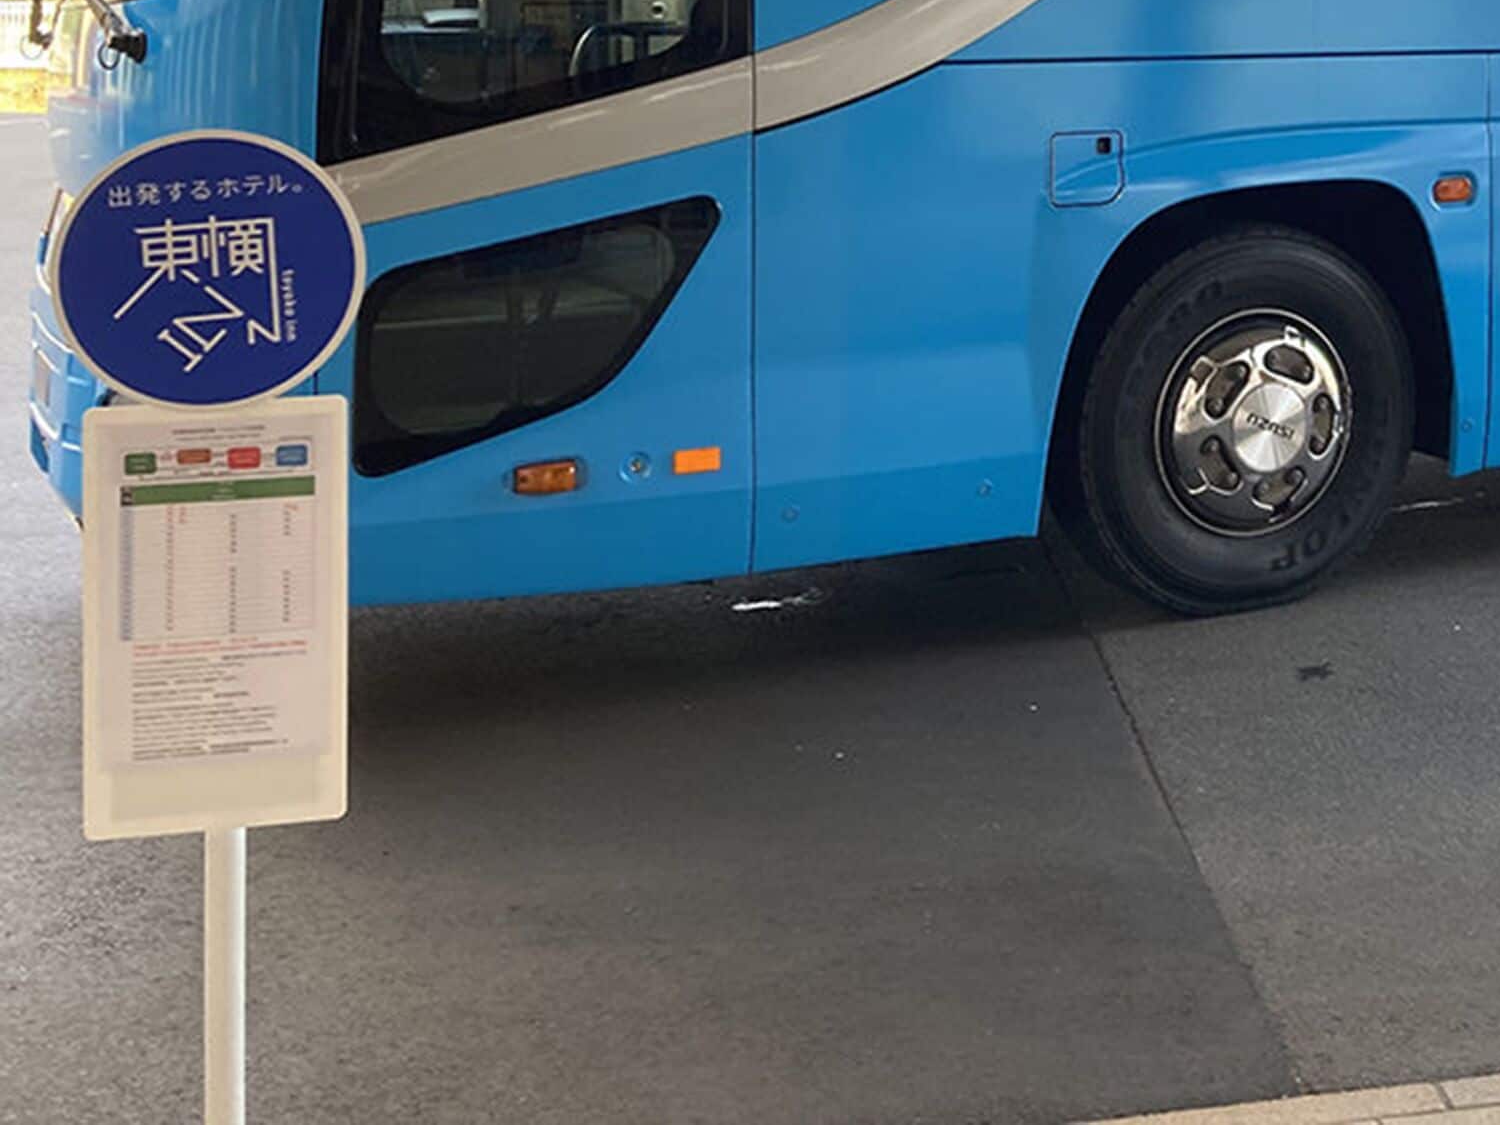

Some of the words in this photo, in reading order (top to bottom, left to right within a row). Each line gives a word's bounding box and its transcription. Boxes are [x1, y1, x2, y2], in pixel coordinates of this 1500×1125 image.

[108, 173, 303, 209] 出発するホテル。
[1246, 412, 1295, 440] ISUZU
